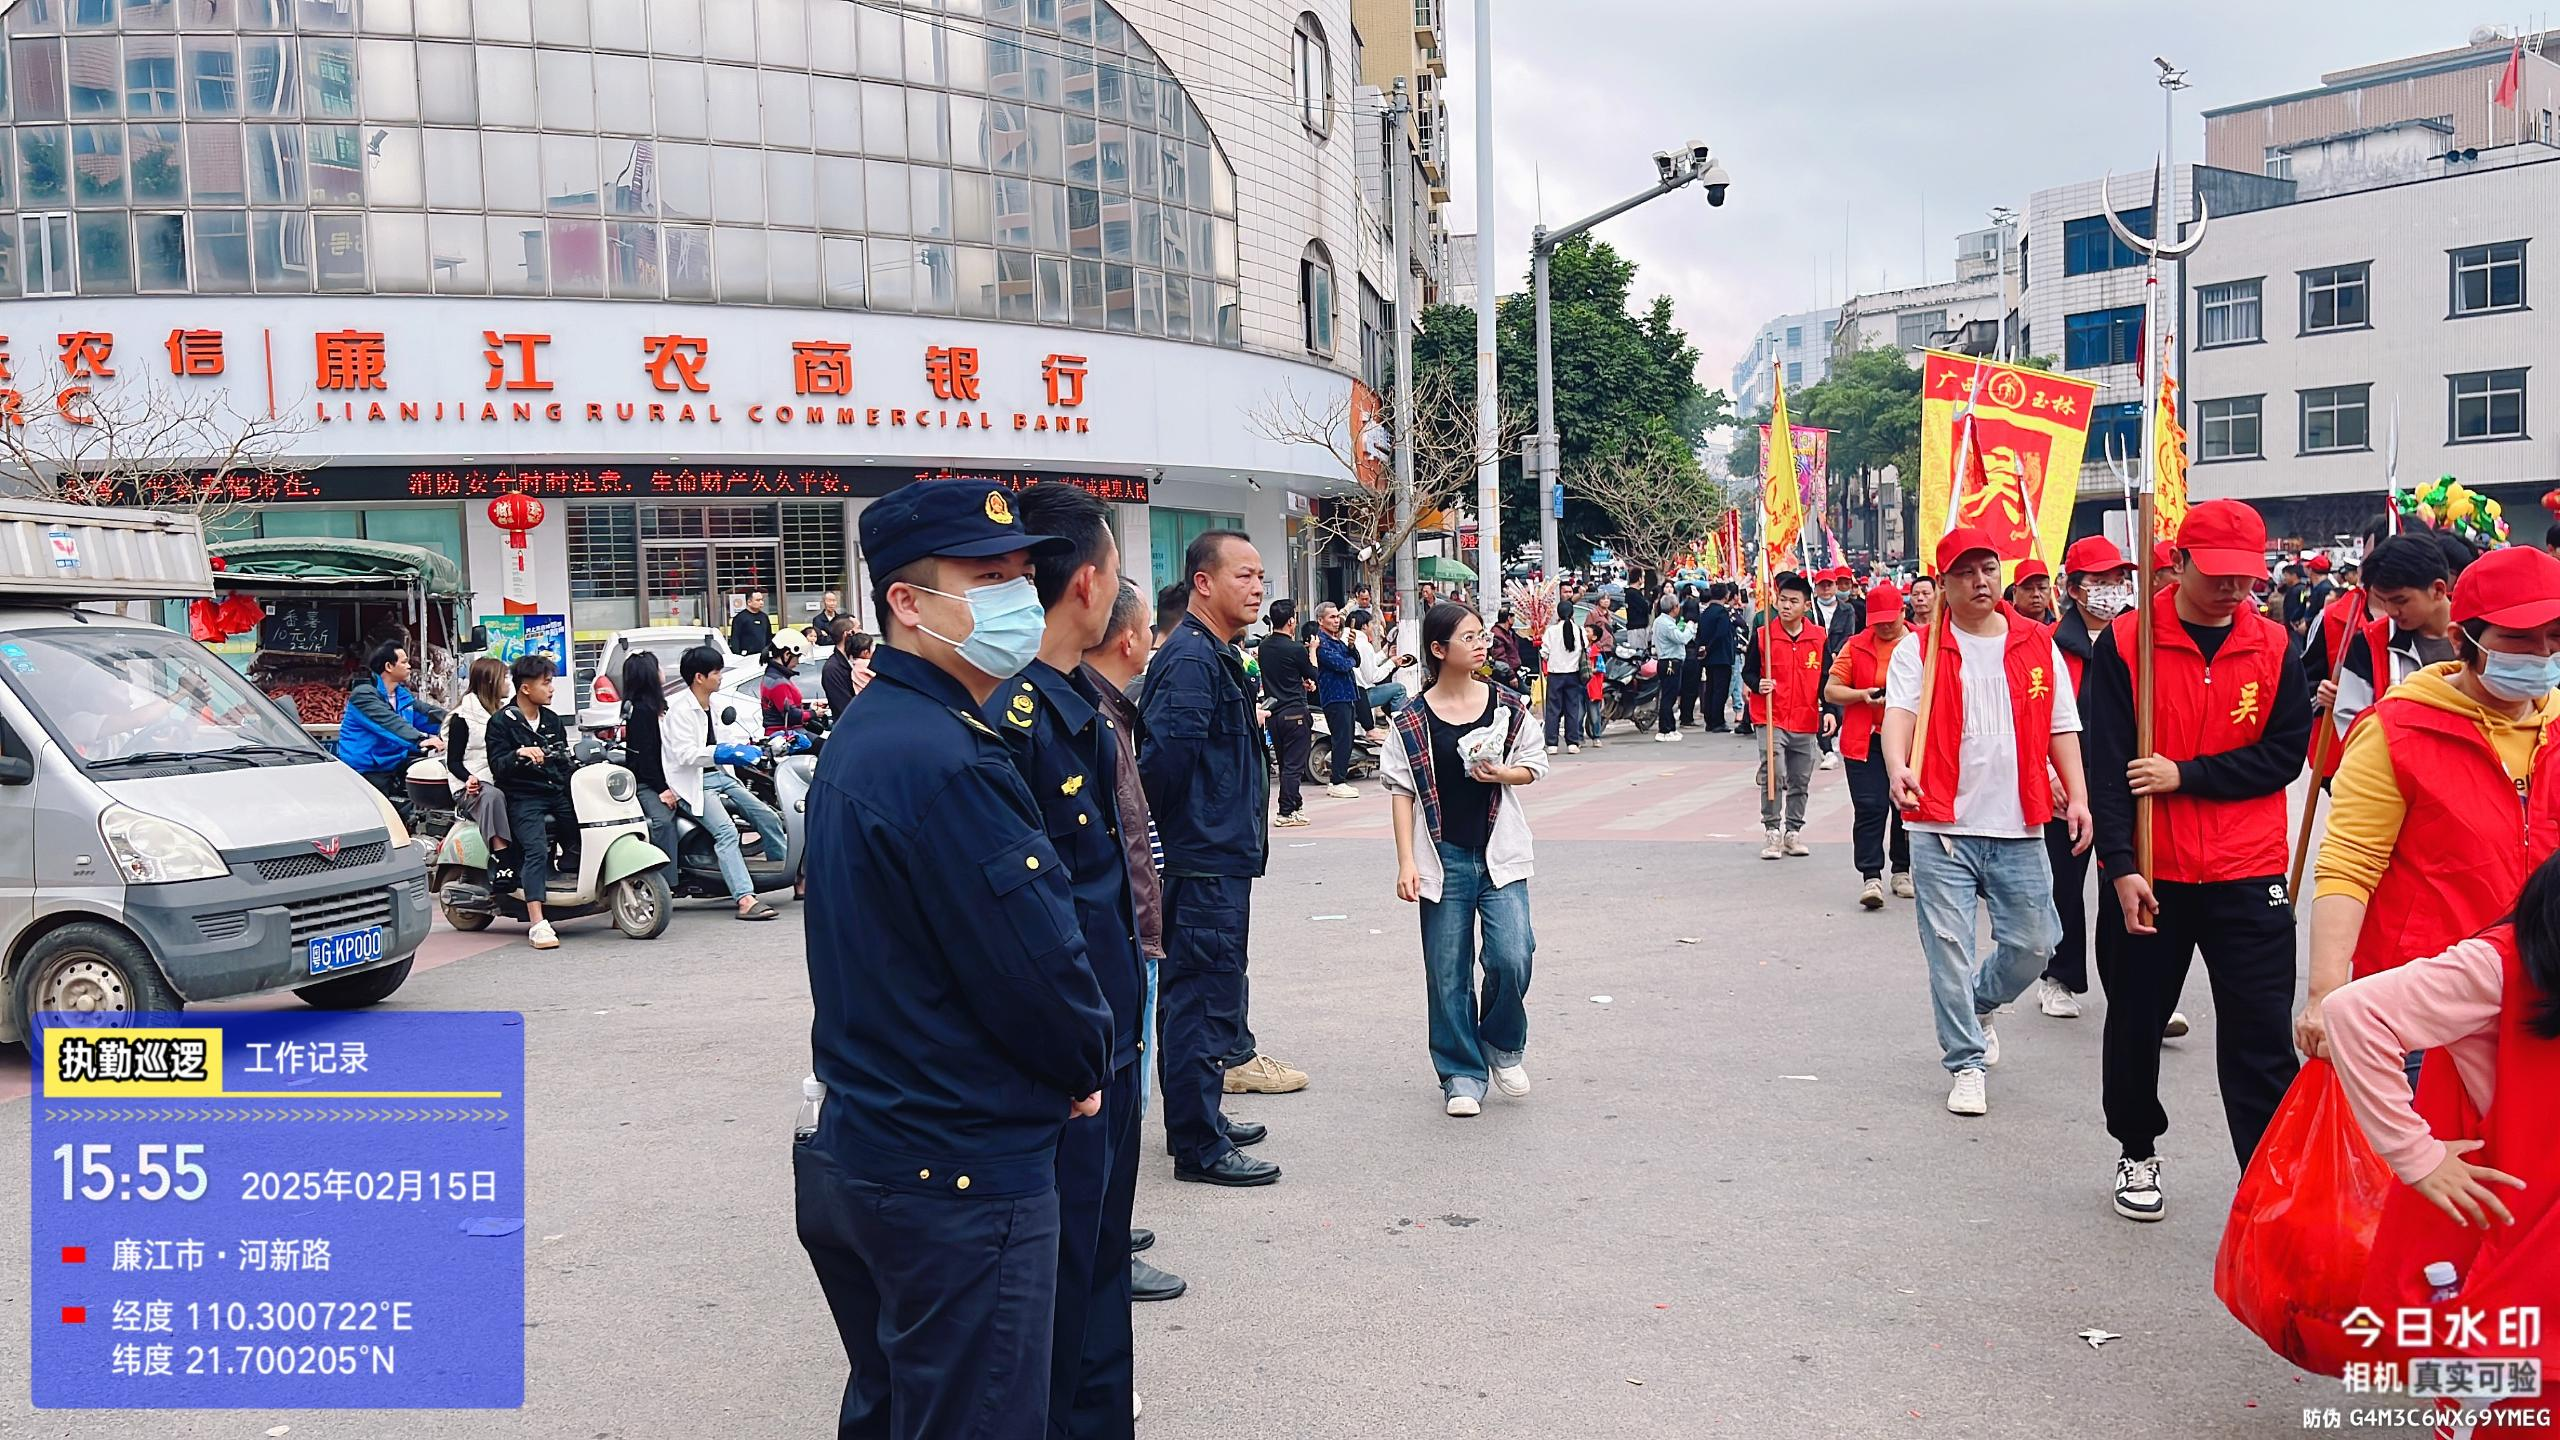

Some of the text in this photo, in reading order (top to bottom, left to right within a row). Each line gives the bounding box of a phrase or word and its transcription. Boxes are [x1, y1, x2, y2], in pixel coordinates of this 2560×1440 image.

[0, 329, 224, 378] 农信
[315, 329, 1088, 406] 廉江农商银行
[317, 402, 1089, 432] LIANJIANG RURAL COMMERCIAL BANK
[2032, 391, 2077, 417] 玉林
[1961, 447, 2020, 525] 吴
[1805, 651, 1820, 669] 吴
[2028, 666, 2049, 700] 吴
[2230, 681, 2259, 725] 吴
